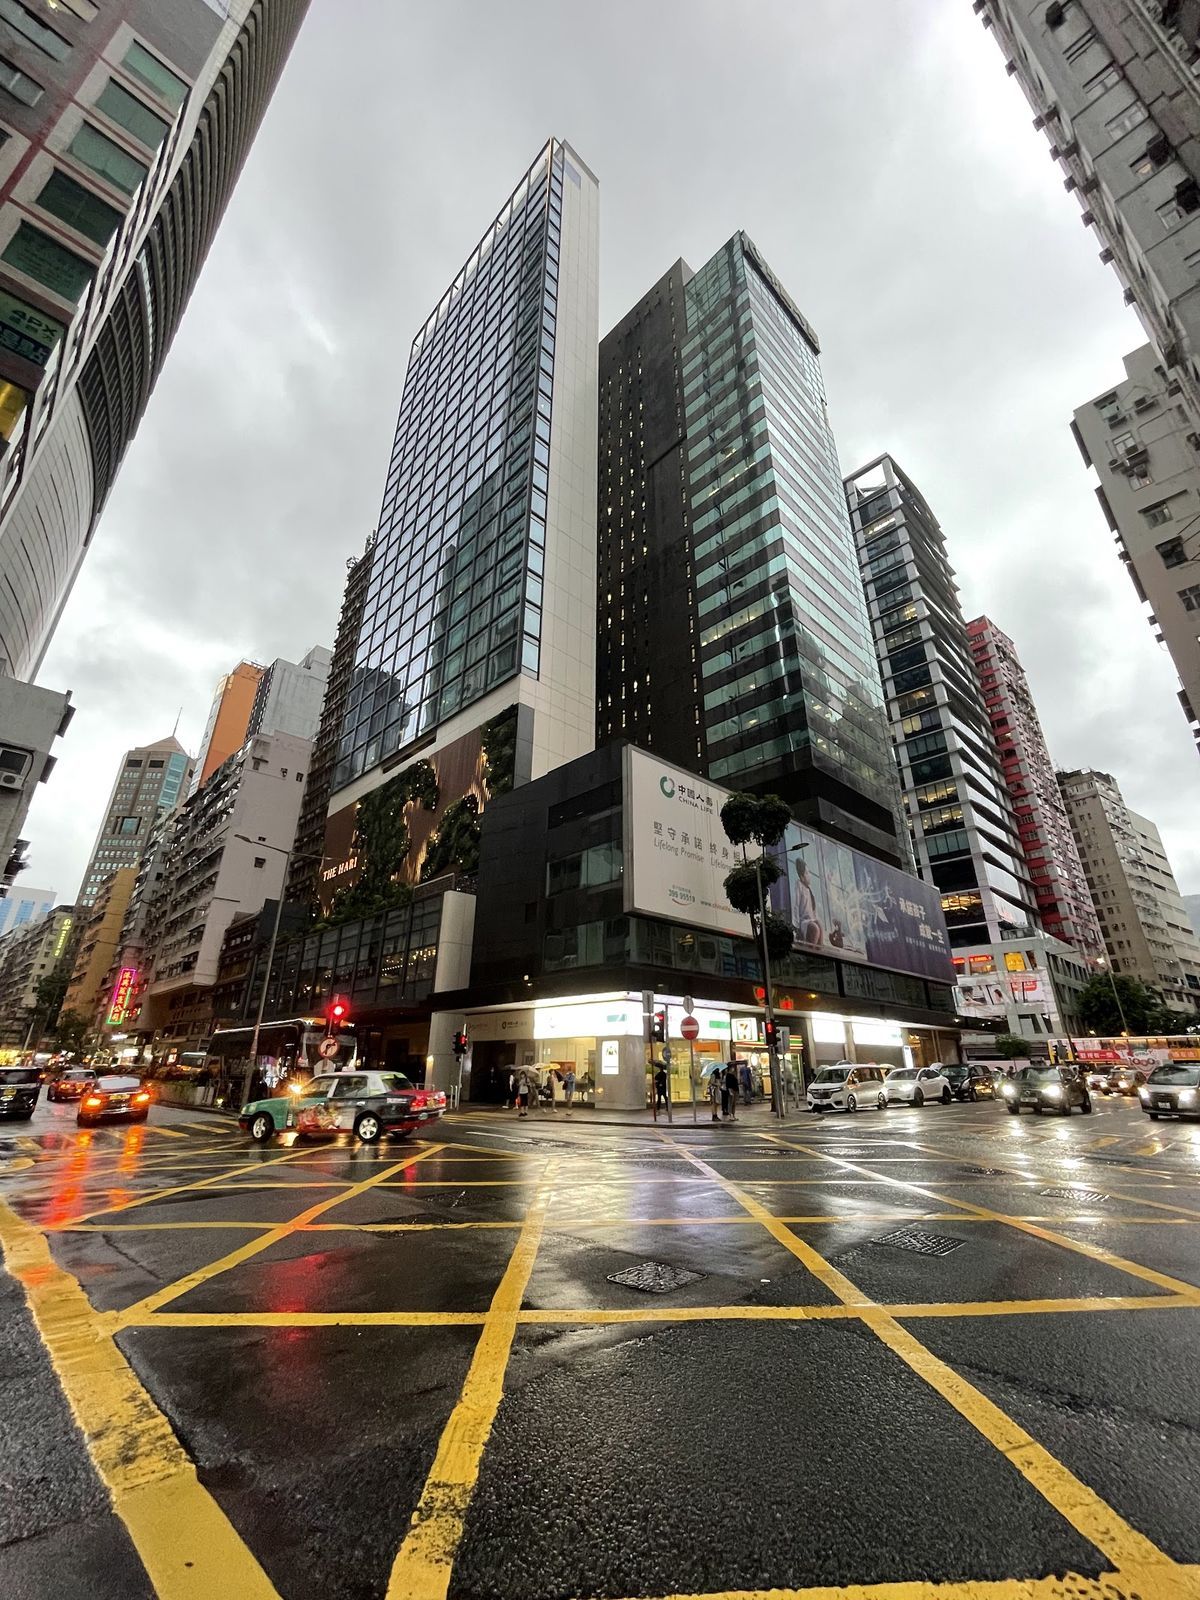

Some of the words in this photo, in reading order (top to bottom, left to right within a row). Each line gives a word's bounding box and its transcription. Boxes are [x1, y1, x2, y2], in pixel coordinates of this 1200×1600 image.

[678, 785, 713, 807] 中國人壽
[679, 796, 699, 809] CHINA
[700, 804, 714, 815] LIFE
[654, 821, 703, 851] 堅守承諾
[654, 838, 679, 856] Lifelong
[680, 846, 704, 863] Promise
[323, 866, 338, 882] THE
